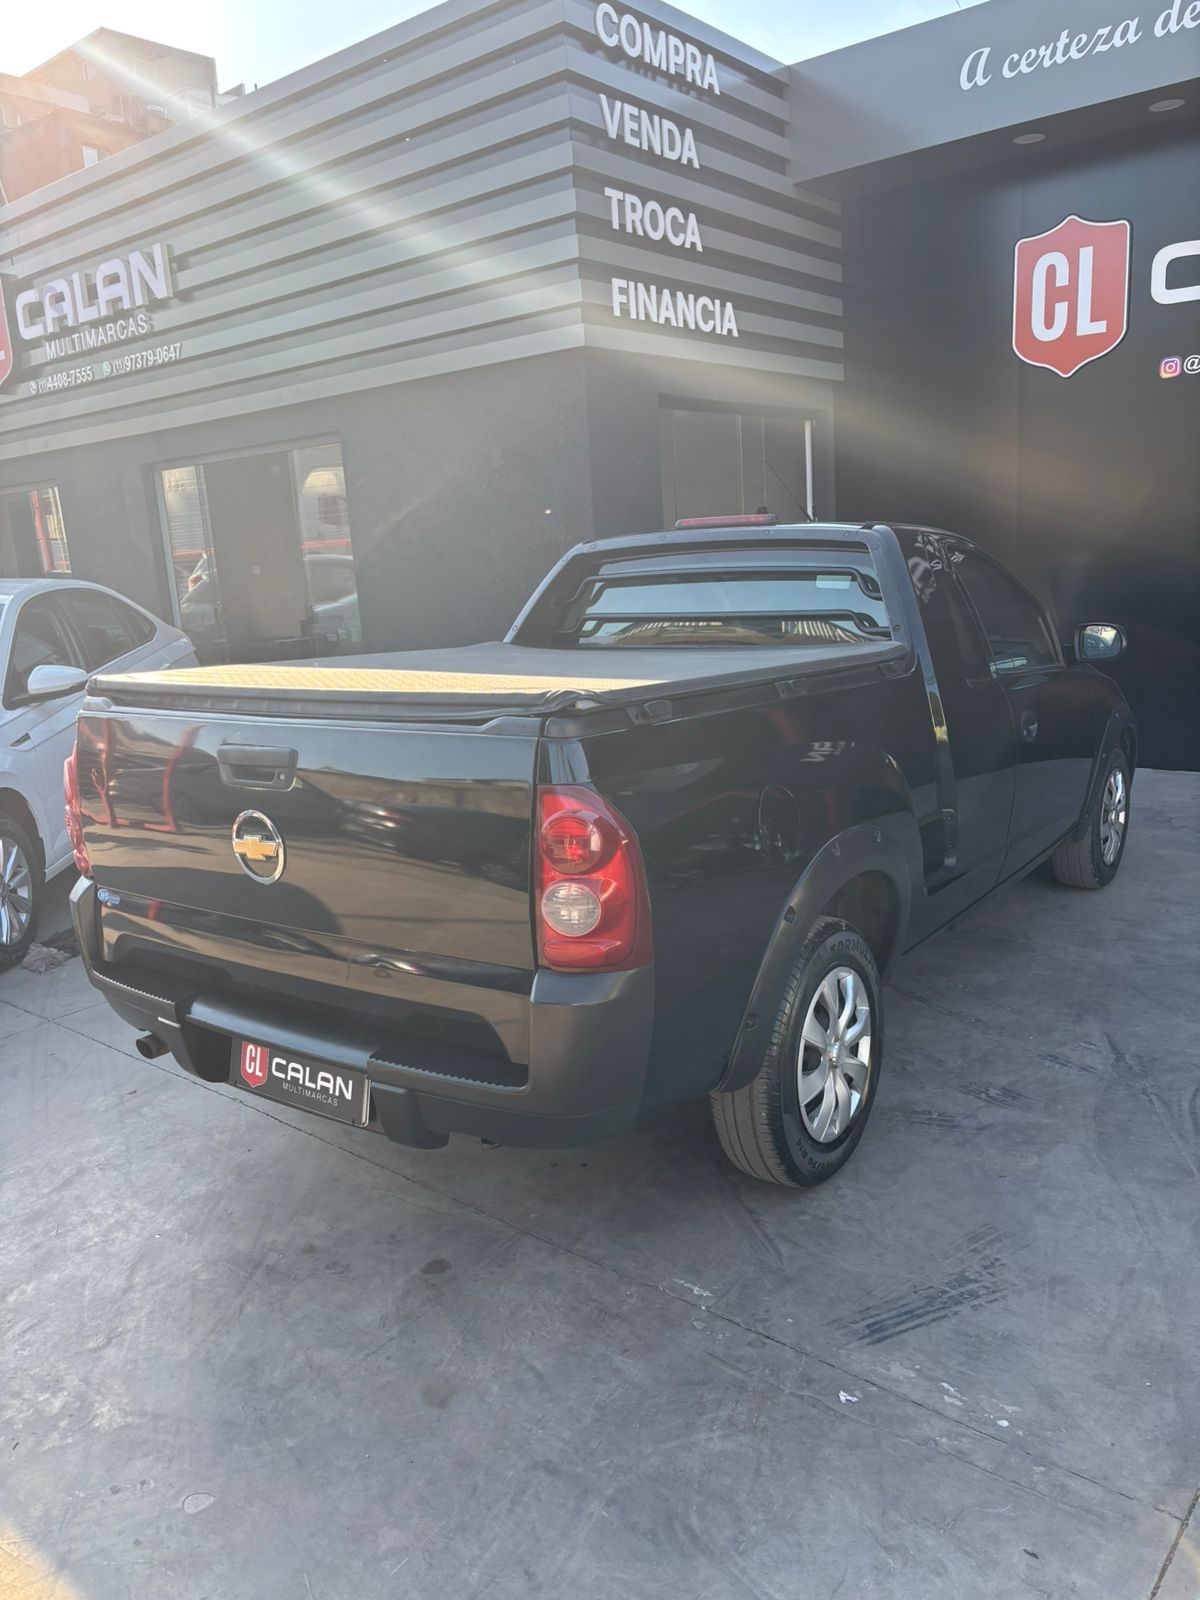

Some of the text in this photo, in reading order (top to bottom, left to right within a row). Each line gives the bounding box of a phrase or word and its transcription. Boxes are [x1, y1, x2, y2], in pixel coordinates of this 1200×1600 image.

[595, 3, 720, 95] COMPRA
[959, 47, 992, 90] A
[1002, 17, 1142, 79] certeza
[599, 93, 700, 169] VENDA
[604, 187, 703, 252] TROCA
[15, 242, 171, 340] CALAN
[611, 278, 738, 337] FINANCIA
[1031, 246, 1107, 342] CL
[45, 314, 149, 360] MULTIMARCAS
[246, 1044, 263, 1077] CL
[272, 1057, 353, 1100] CALAN
[282, 1082, 338, 1107] MULTIMARCAS
